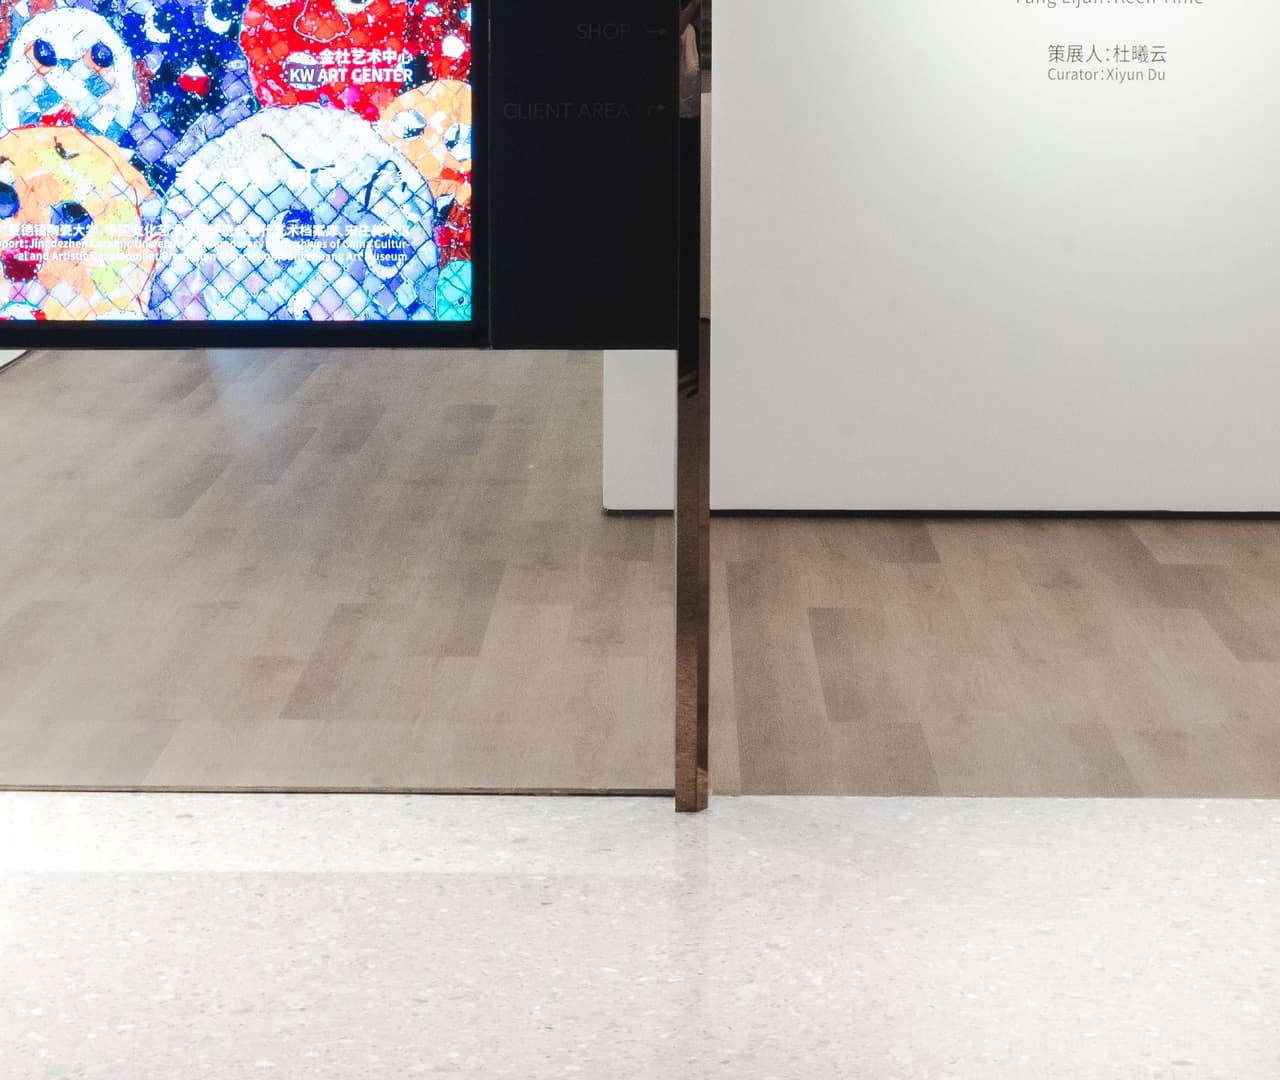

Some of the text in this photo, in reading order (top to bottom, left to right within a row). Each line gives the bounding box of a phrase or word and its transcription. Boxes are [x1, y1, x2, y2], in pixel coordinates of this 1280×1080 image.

[575, 23, 632, 40] SHOP
[319, 47, 413, 65] 金社艺术中心
[1047, 44, 1167, 64] 策展人：杜曦云
[289, 68, 413, 83] KW ART CENTER
[1148, 68, 1166, 81] Du
[503, 103, 631, 120] CLIENT AREA
